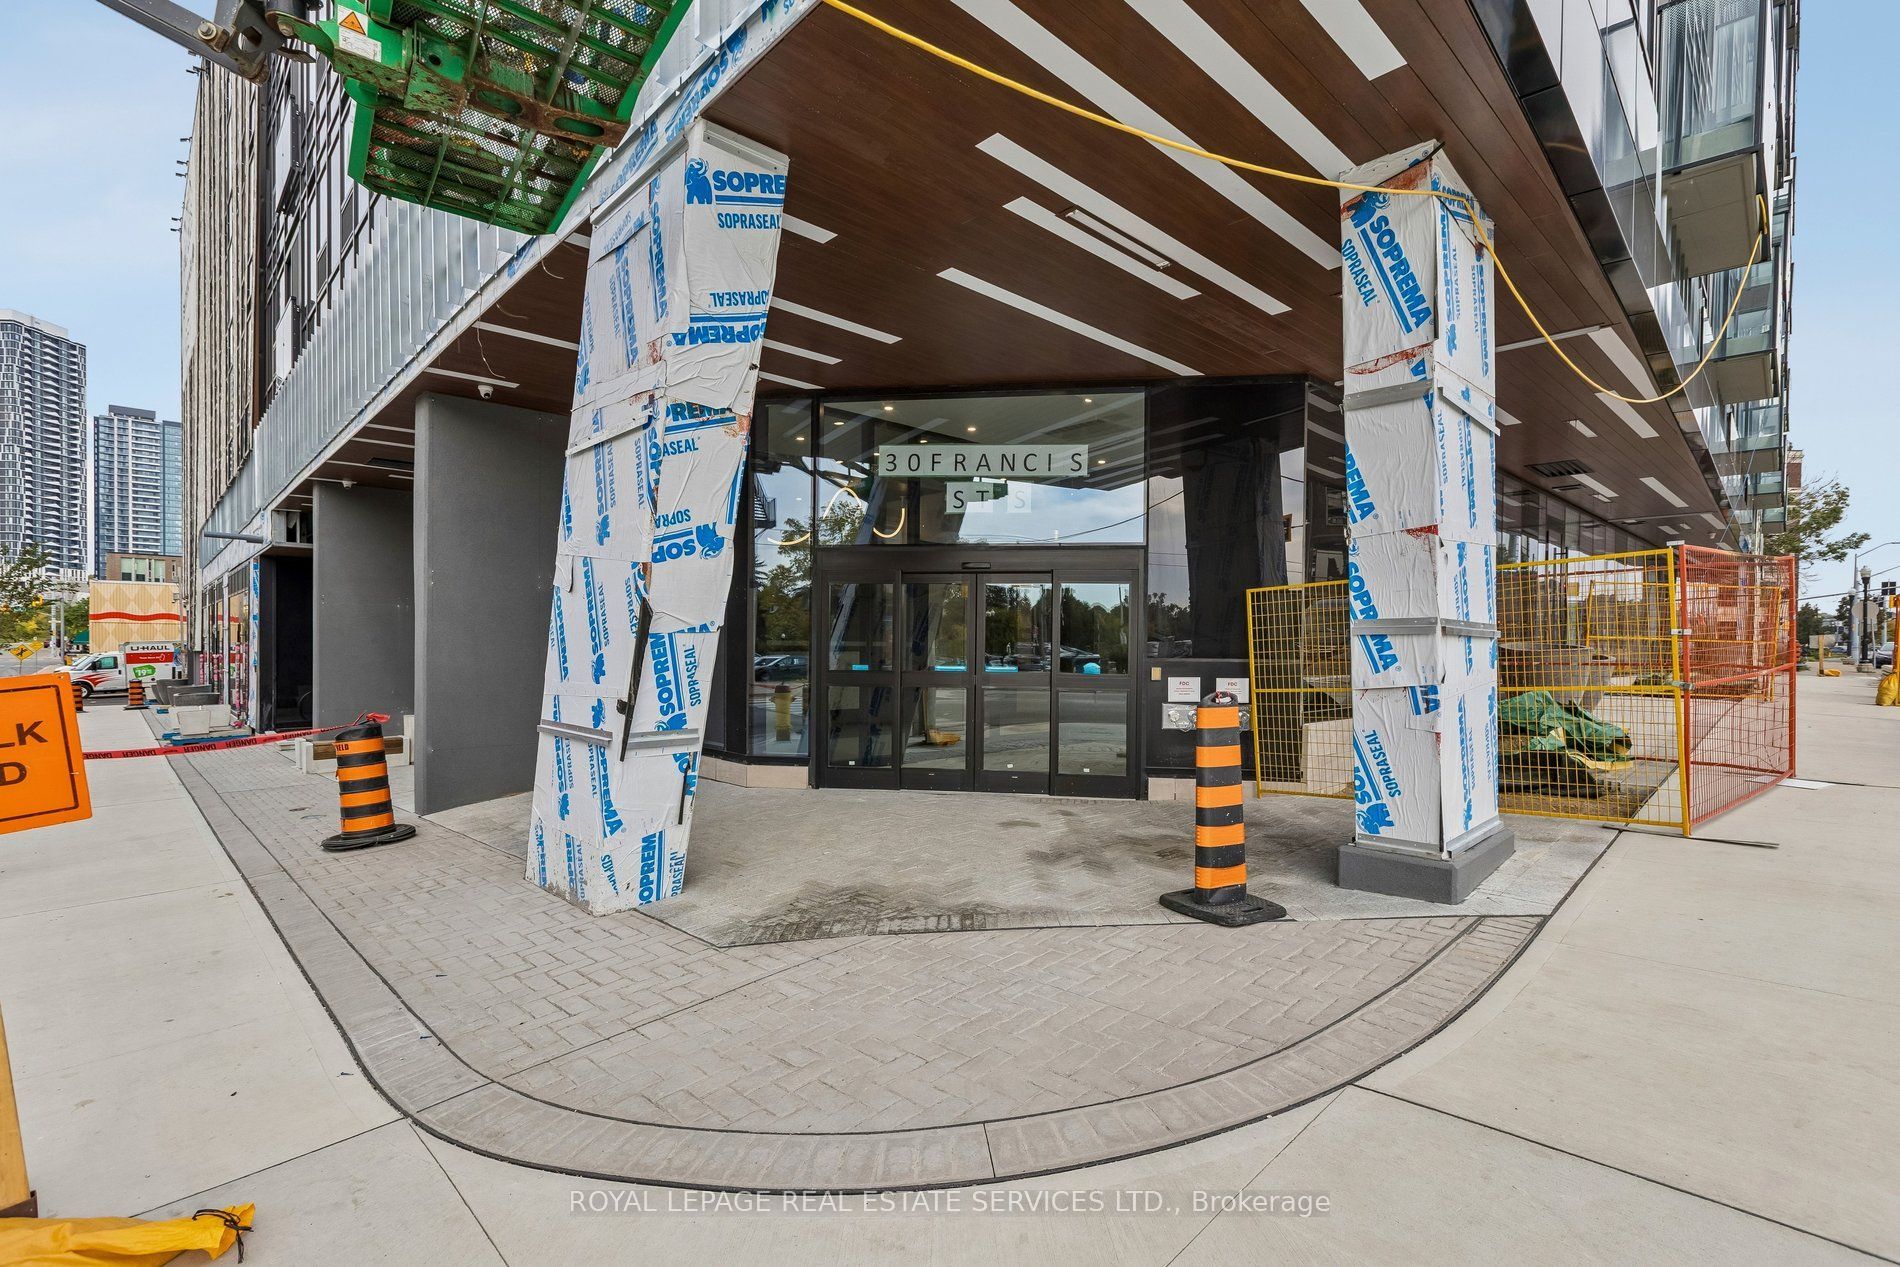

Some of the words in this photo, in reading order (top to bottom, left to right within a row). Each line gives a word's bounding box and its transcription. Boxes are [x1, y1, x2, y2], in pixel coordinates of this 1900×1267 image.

[651, 202, 668, 319] SOPREMA
[1341, 239, 1377, 307] SOPRASEAL
[1370, 215, 1433, 329] SOPREMA
[621, 256, 638, 365] SOPREMA
[1480, 265, 1489, 377] SOPREMA
[606, 441, 617, 508] SOPRASEAL
[634, 438, 645, 509] SOPRASEAL
[554, 586, 569, 680] SOPREMA
[583, 557, 599, 655] SOPREMA
[598, 584, 610, 646] SOPRASEAL
[684, 644, 701, 707] SOPRASEAL
[183, 743, 216, 752] DANGER
[226, 737, 257, 748] DANGER
[1364, 729, 1402, 798] SOPRASEAL
[638, 832, 657, 906] OPREM
